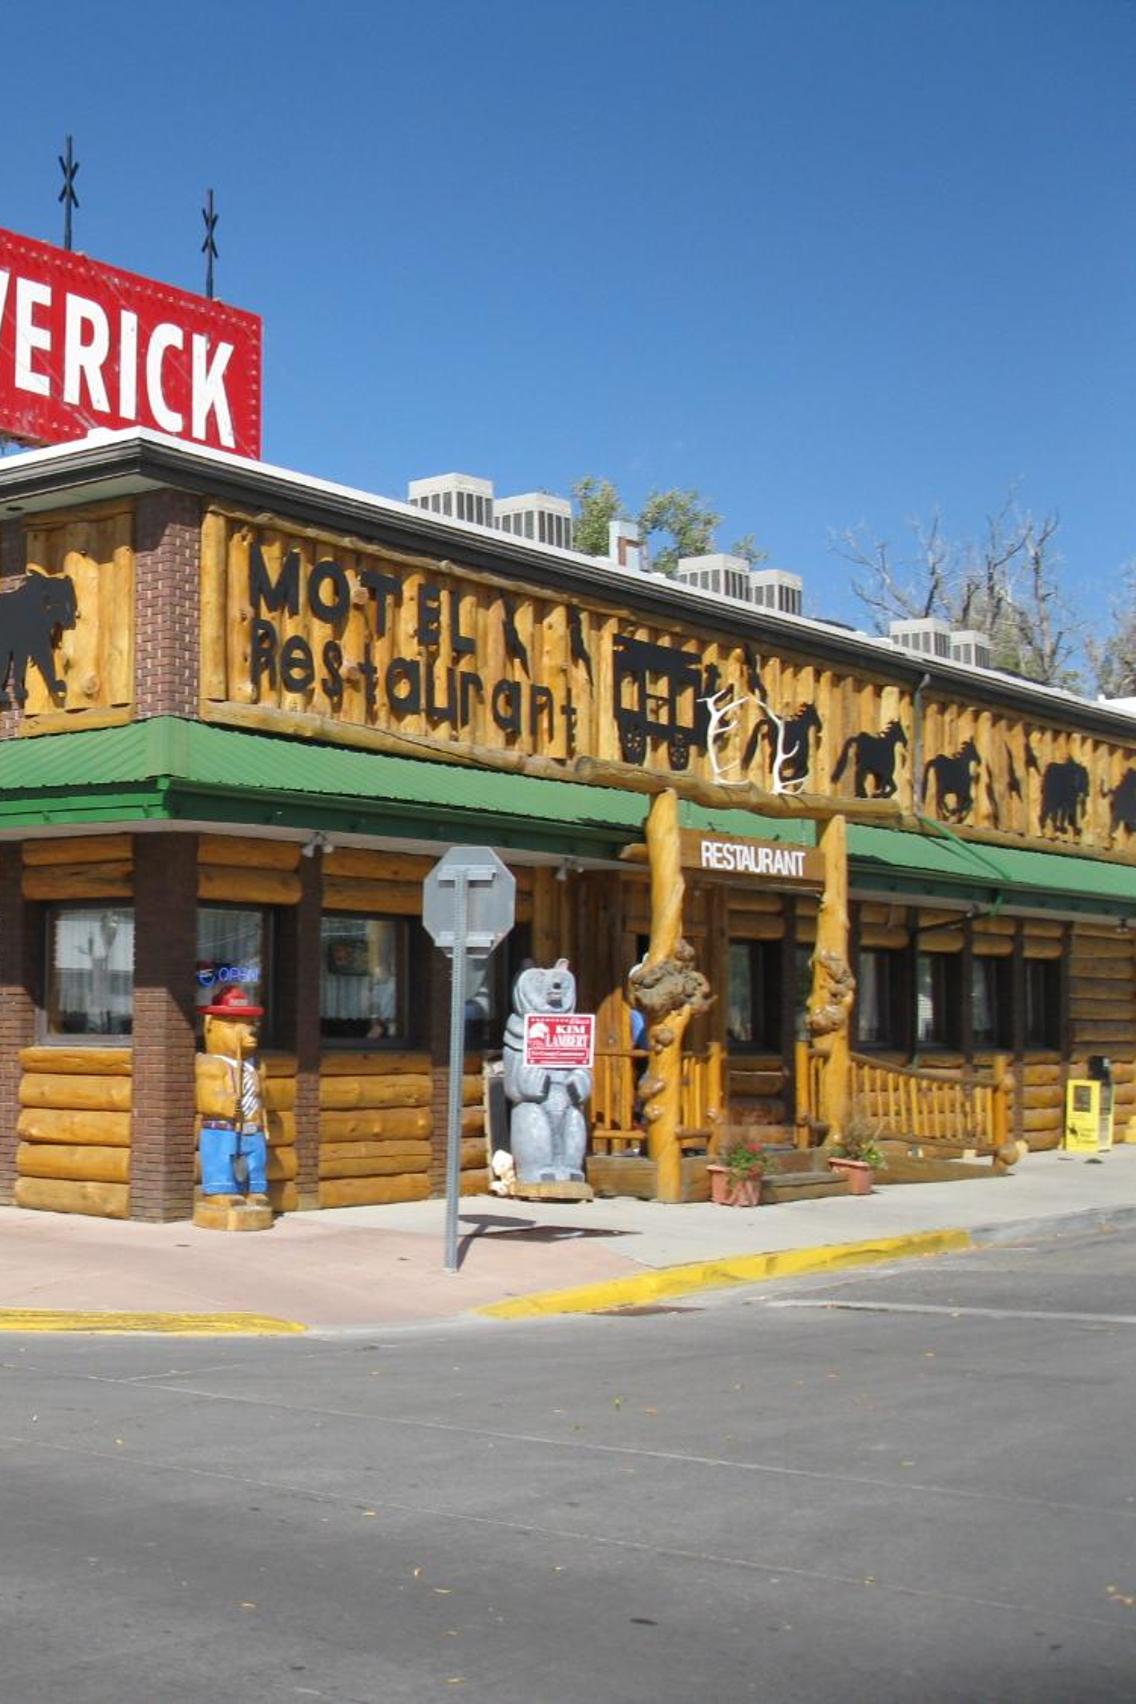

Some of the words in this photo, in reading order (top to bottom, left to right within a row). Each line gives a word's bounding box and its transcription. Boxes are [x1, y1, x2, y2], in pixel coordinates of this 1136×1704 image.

[250, 543, 477, 656] MOTEL
[250, 618, 577, 744] Restaurant
[701, 840, 806, 877] RESTAURANT
[555, 1025, 585, 1034] KIM
